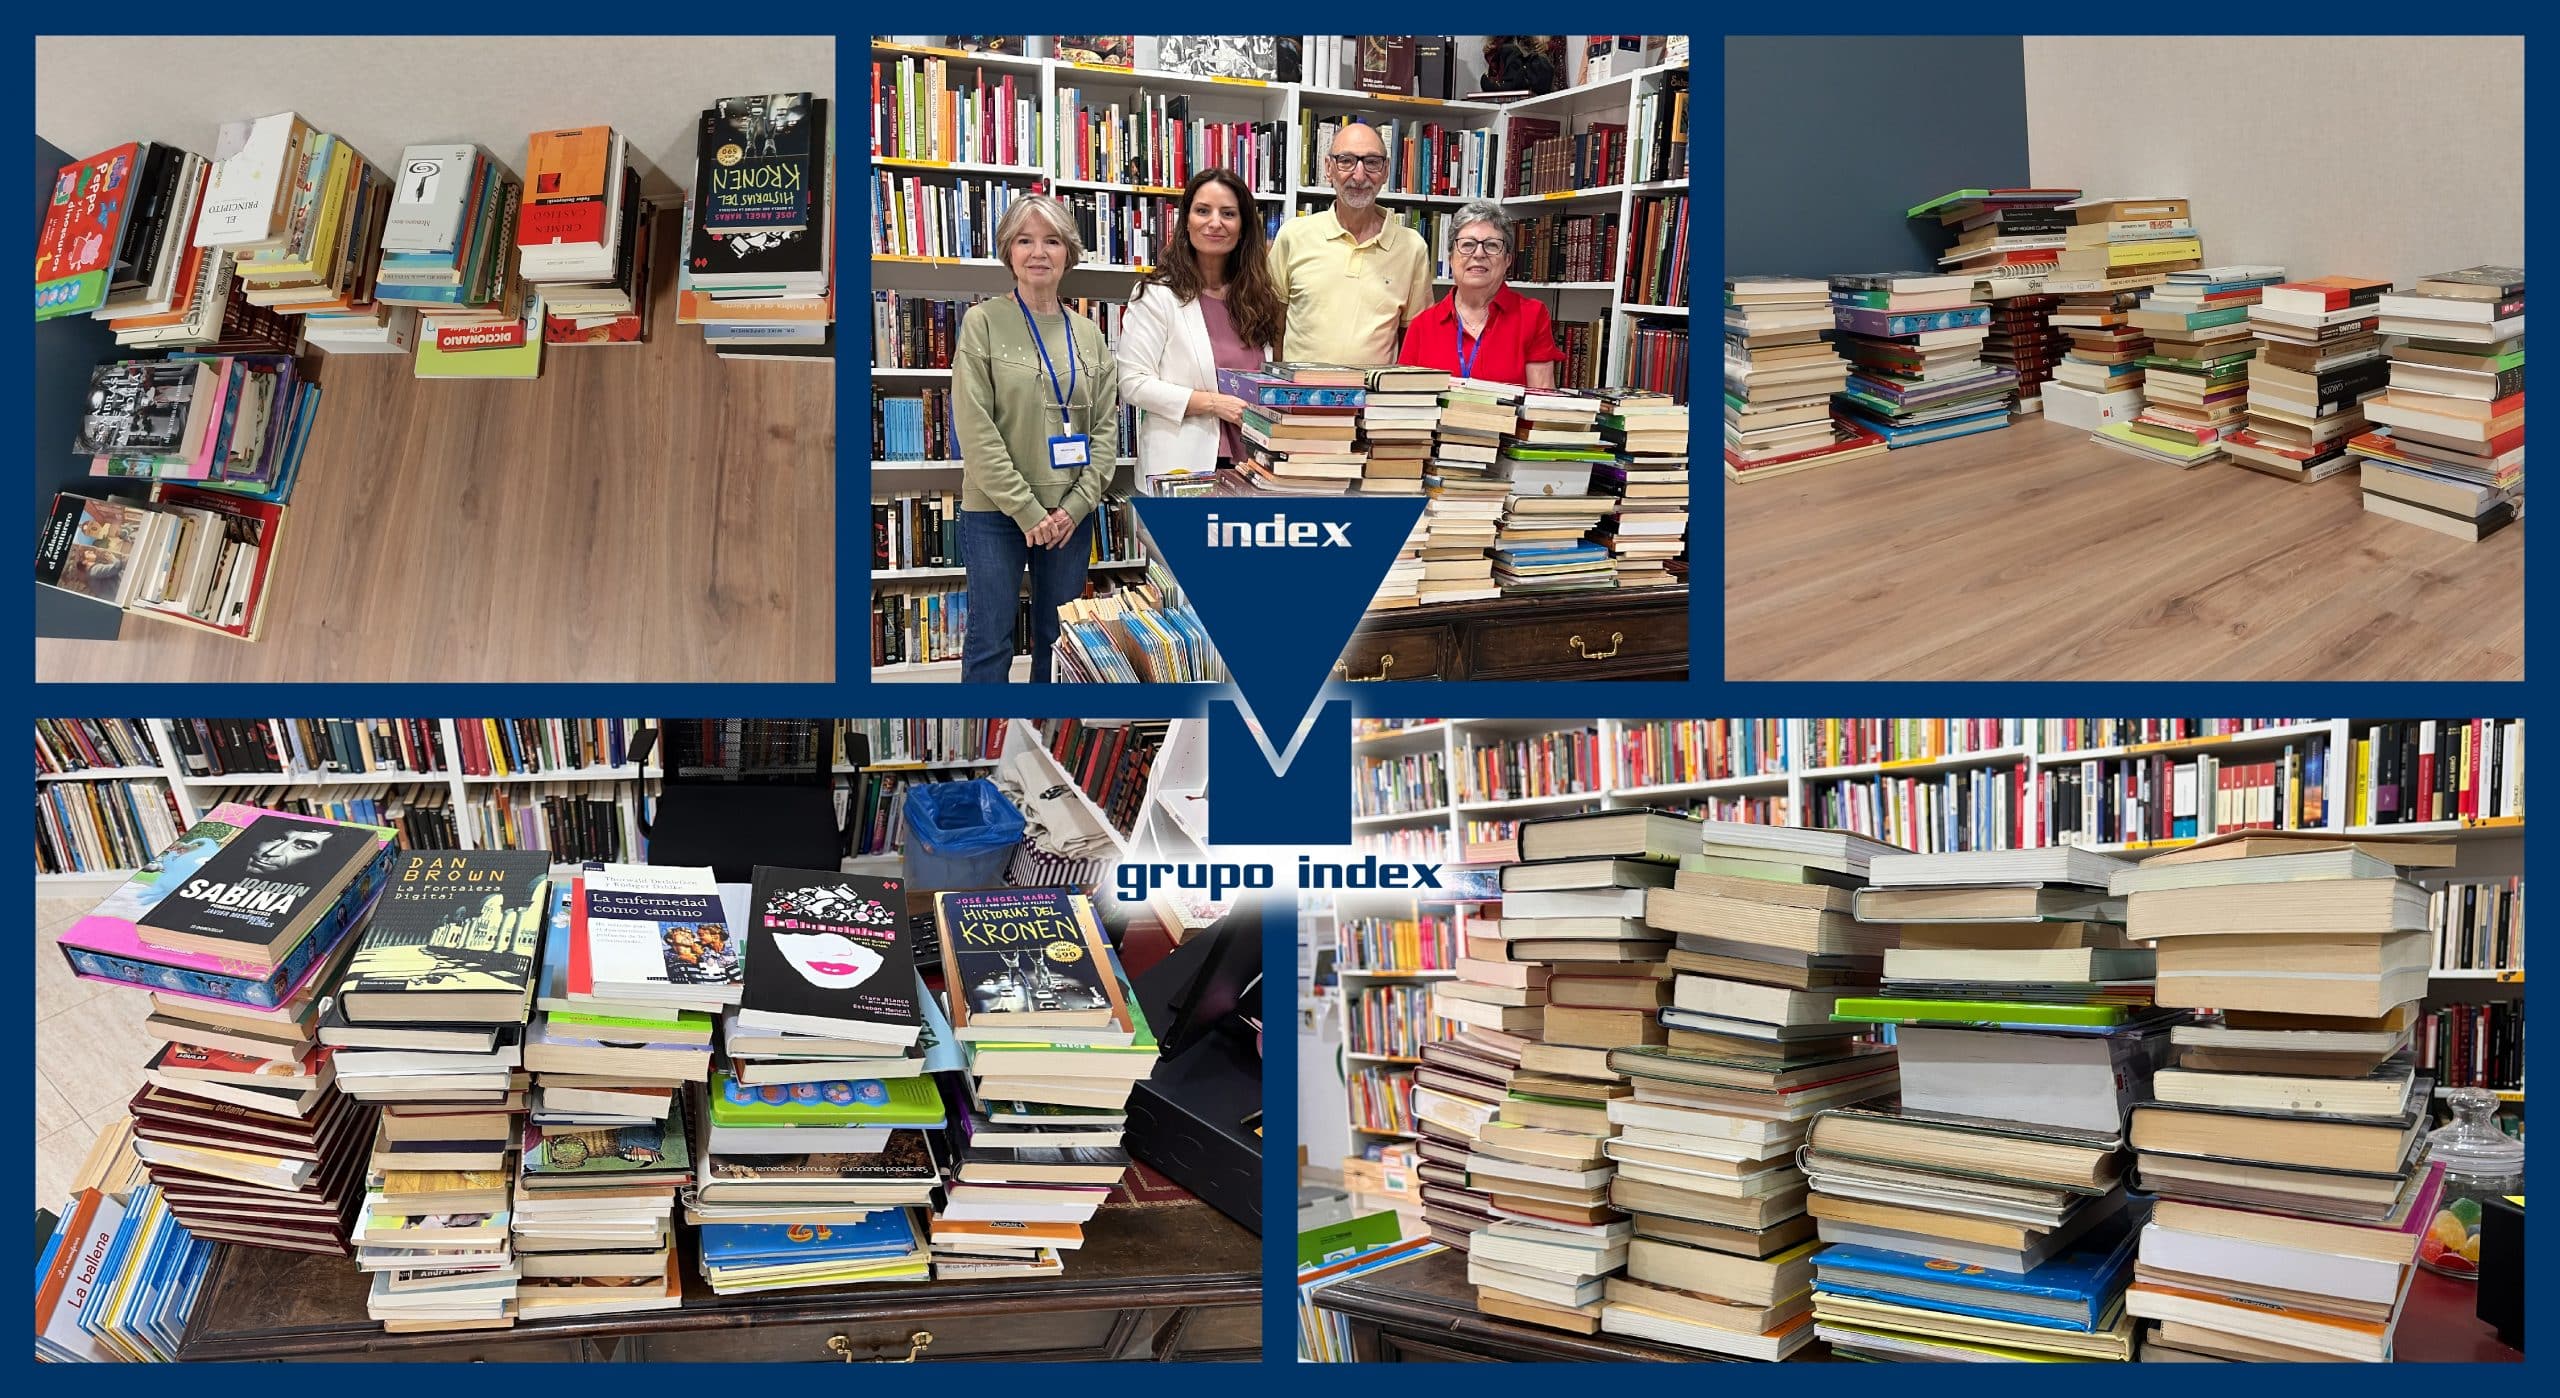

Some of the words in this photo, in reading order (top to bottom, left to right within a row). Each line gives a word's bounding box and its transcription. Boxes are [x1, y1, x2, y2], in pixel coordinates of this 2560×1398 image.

[713, 163, 800, 193] KRONEN
[86, 162, 108, 215] Peppa
[717, 194, 739, 206] DEL
[741, 191, 795, 206] HISTORIAS
[208, 201, 259, 214] PRINCIPITO
[52, 201, 75, 272] dinosaurios
[443, 332, 512, 346] DICCIONARIO
[53, 512, 73, 560] aventurero
[408, 857, 467, 869] DAN
[403, 869, 505, 882] BROWN
[232, 877, 311, 898] JOAQUÍN
[179, 879, 297, 914] SABINA
[394, 893, 455, 901] Digital
[593, 893, 611, 903] La
[616, 896, 708, 907] enfermedad
[956, 896, 981, 905] JOSÉ
[986, 895, 1019, 904] ÁNGEL
[594, 905, 639, 915] como
[644, 908, 703, 918] camino
[962, 906, 1029, 920] HISTORIAS
[1031, 906, 1062, 917] DEL
[959, 916, 1079, 946] KRONEN
[77, 1232, 110, 1285] ballena
[68, 1287, 87, 1309] La
